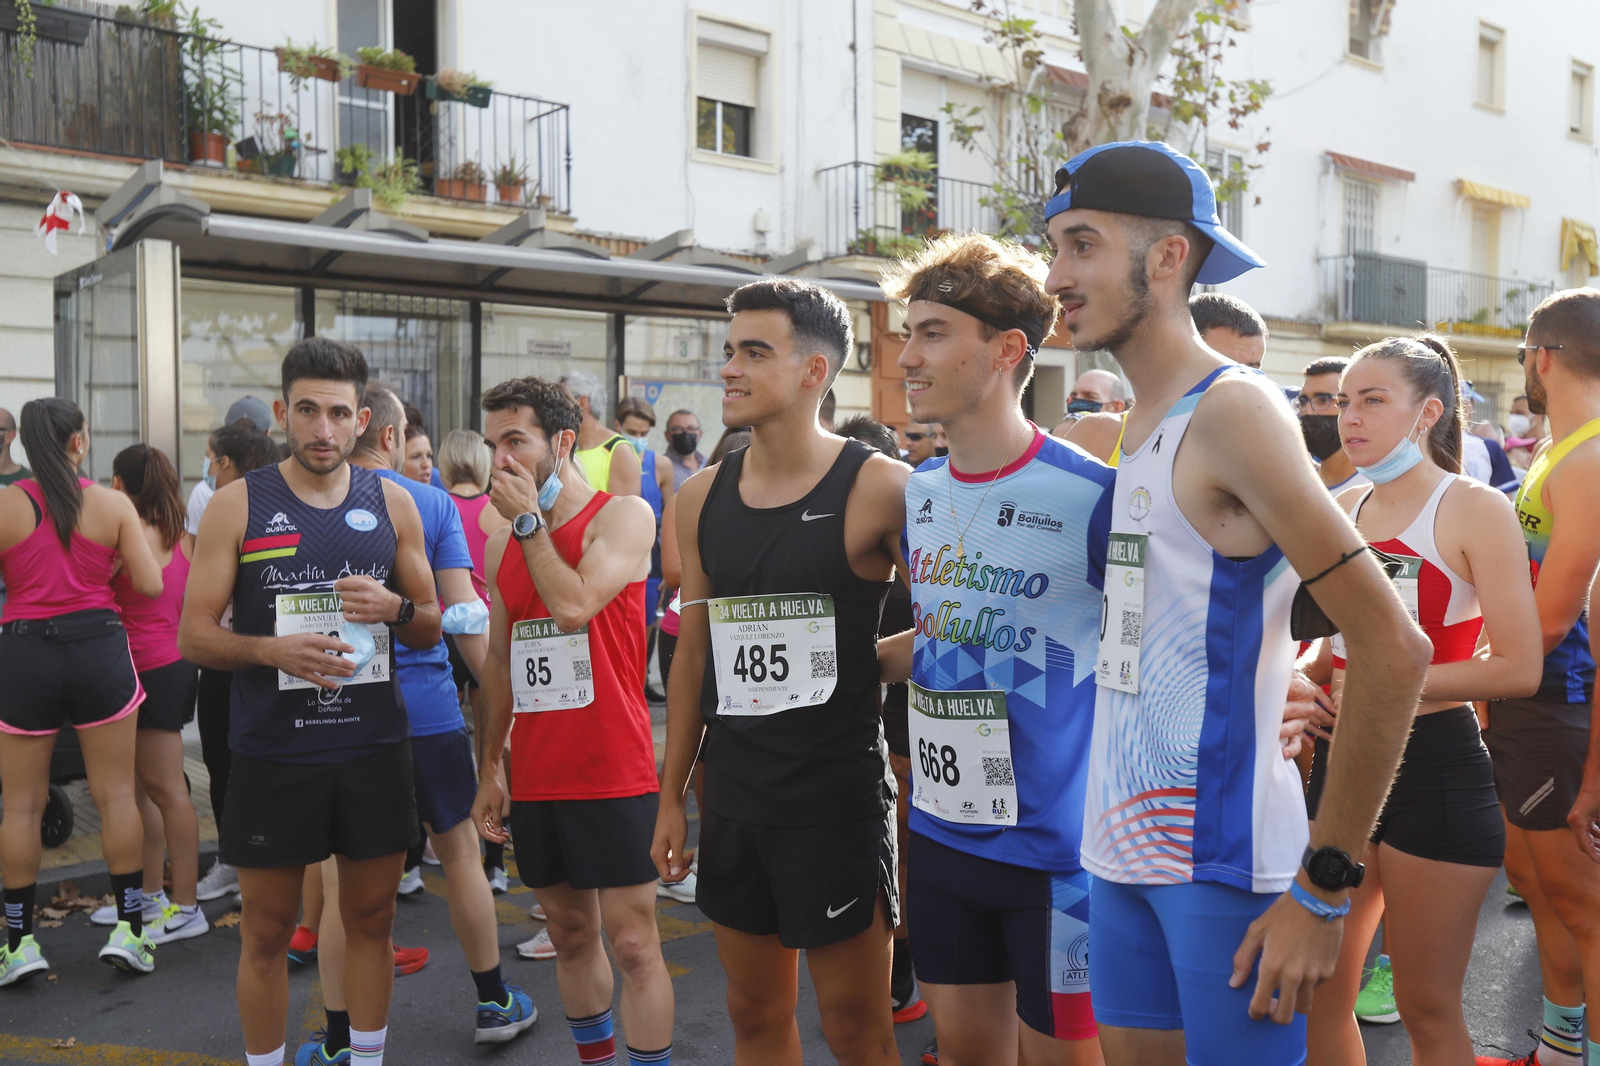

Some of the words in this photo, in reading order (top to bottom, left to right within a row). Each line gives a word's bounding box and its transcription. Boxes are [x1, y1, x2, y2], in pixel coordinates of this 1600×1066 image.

[680, 340, 688, 358] 3
[1018, 514, 1063, 528] Bollullos
[1036, 525, 1062, 534] Condado
[1112, 540, 1139, 562] HUELVA
[261, 564, 326, 584] Martín
[910, 544, 1050, 600] Atletismo
[284, 600, 296, 612] 34
[299, 598, 335, 612] VUELTA
[718, 605, 730, 620] 34
[731, 602, 766, 620] VUELTA
[770, 602, 777, 618] A
[780, 599, 824, 617] HUELVA
[304, 614, 338, 622] MANUEL
[738, 622, 768, 632] ADRIÁN
[911, 600, 1037, 653] Bollullos
[520, 624, 541, 638] VUELTA
[544, 623, 549, 636] A
[526, 656, 552, 687] 85
[734, 644, 789, 683] 485
[917, 692, 935, 715] VUELTA
[938, 698, 945, 716] A
[947, 698, 996, 716] HUELVA
[306, 718, 336, 726] BEBELINDO
[338, 716, 360, 724] ALMONTE
[918, 737, 960, 787] 668
